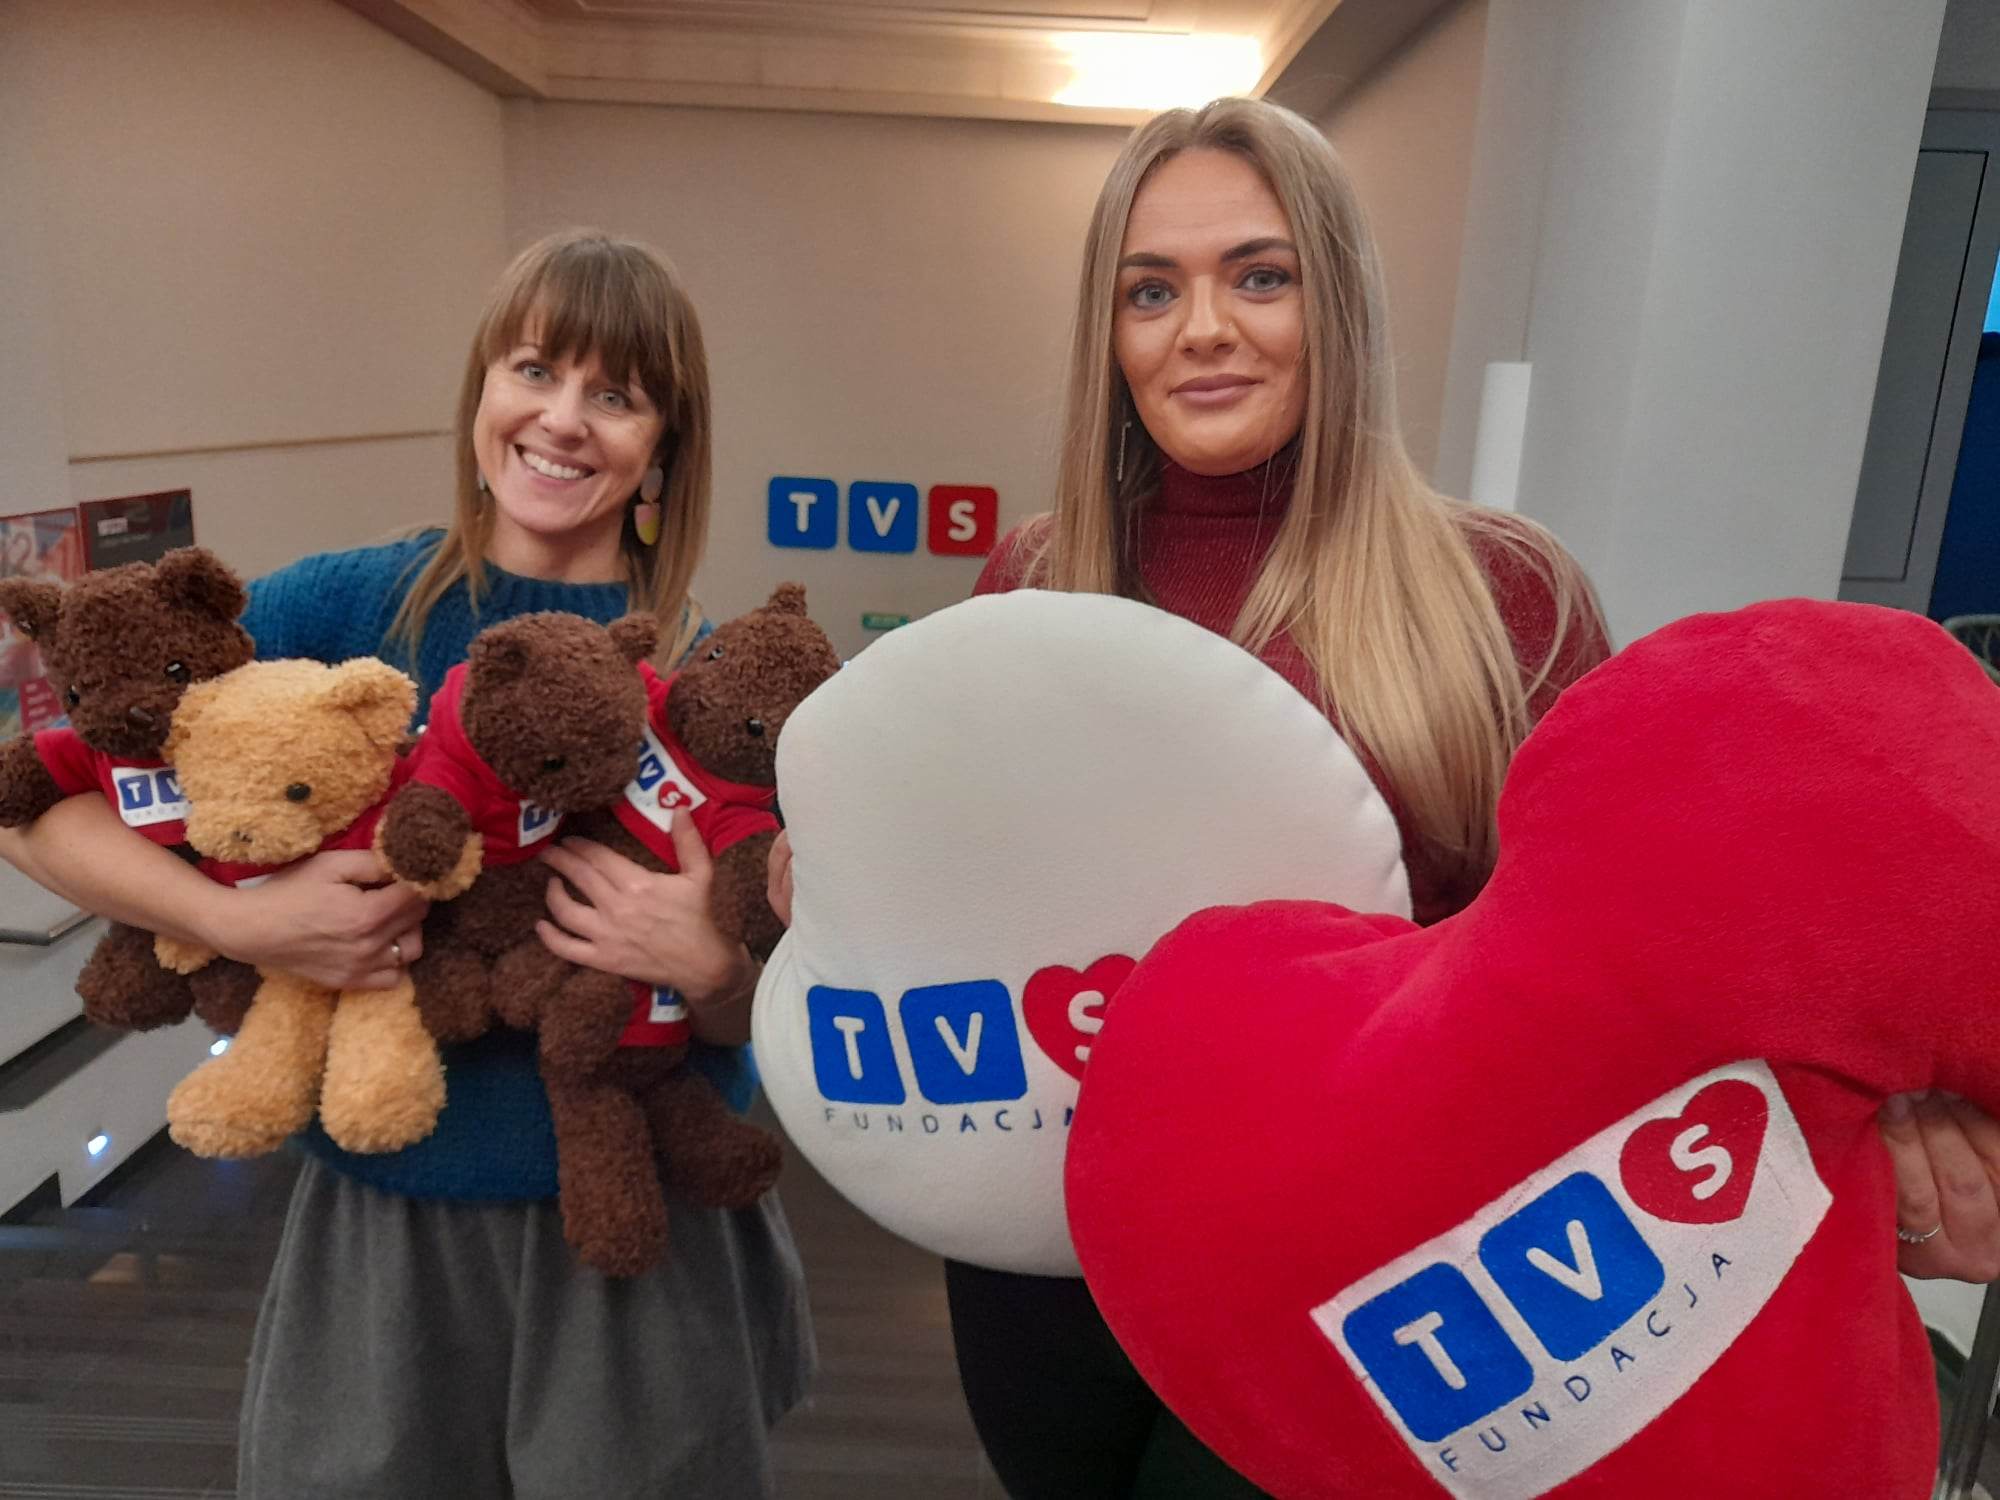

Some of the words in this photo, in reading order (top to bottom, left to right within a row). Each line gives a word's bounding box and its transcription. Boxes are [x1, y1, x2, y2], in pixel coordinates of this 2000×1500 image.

[788, 492, 977, 542] TVS
[1393, 1123, 1734, 1391] TVS
[1438, 1251, 1733, 1473] FUNDACJA
